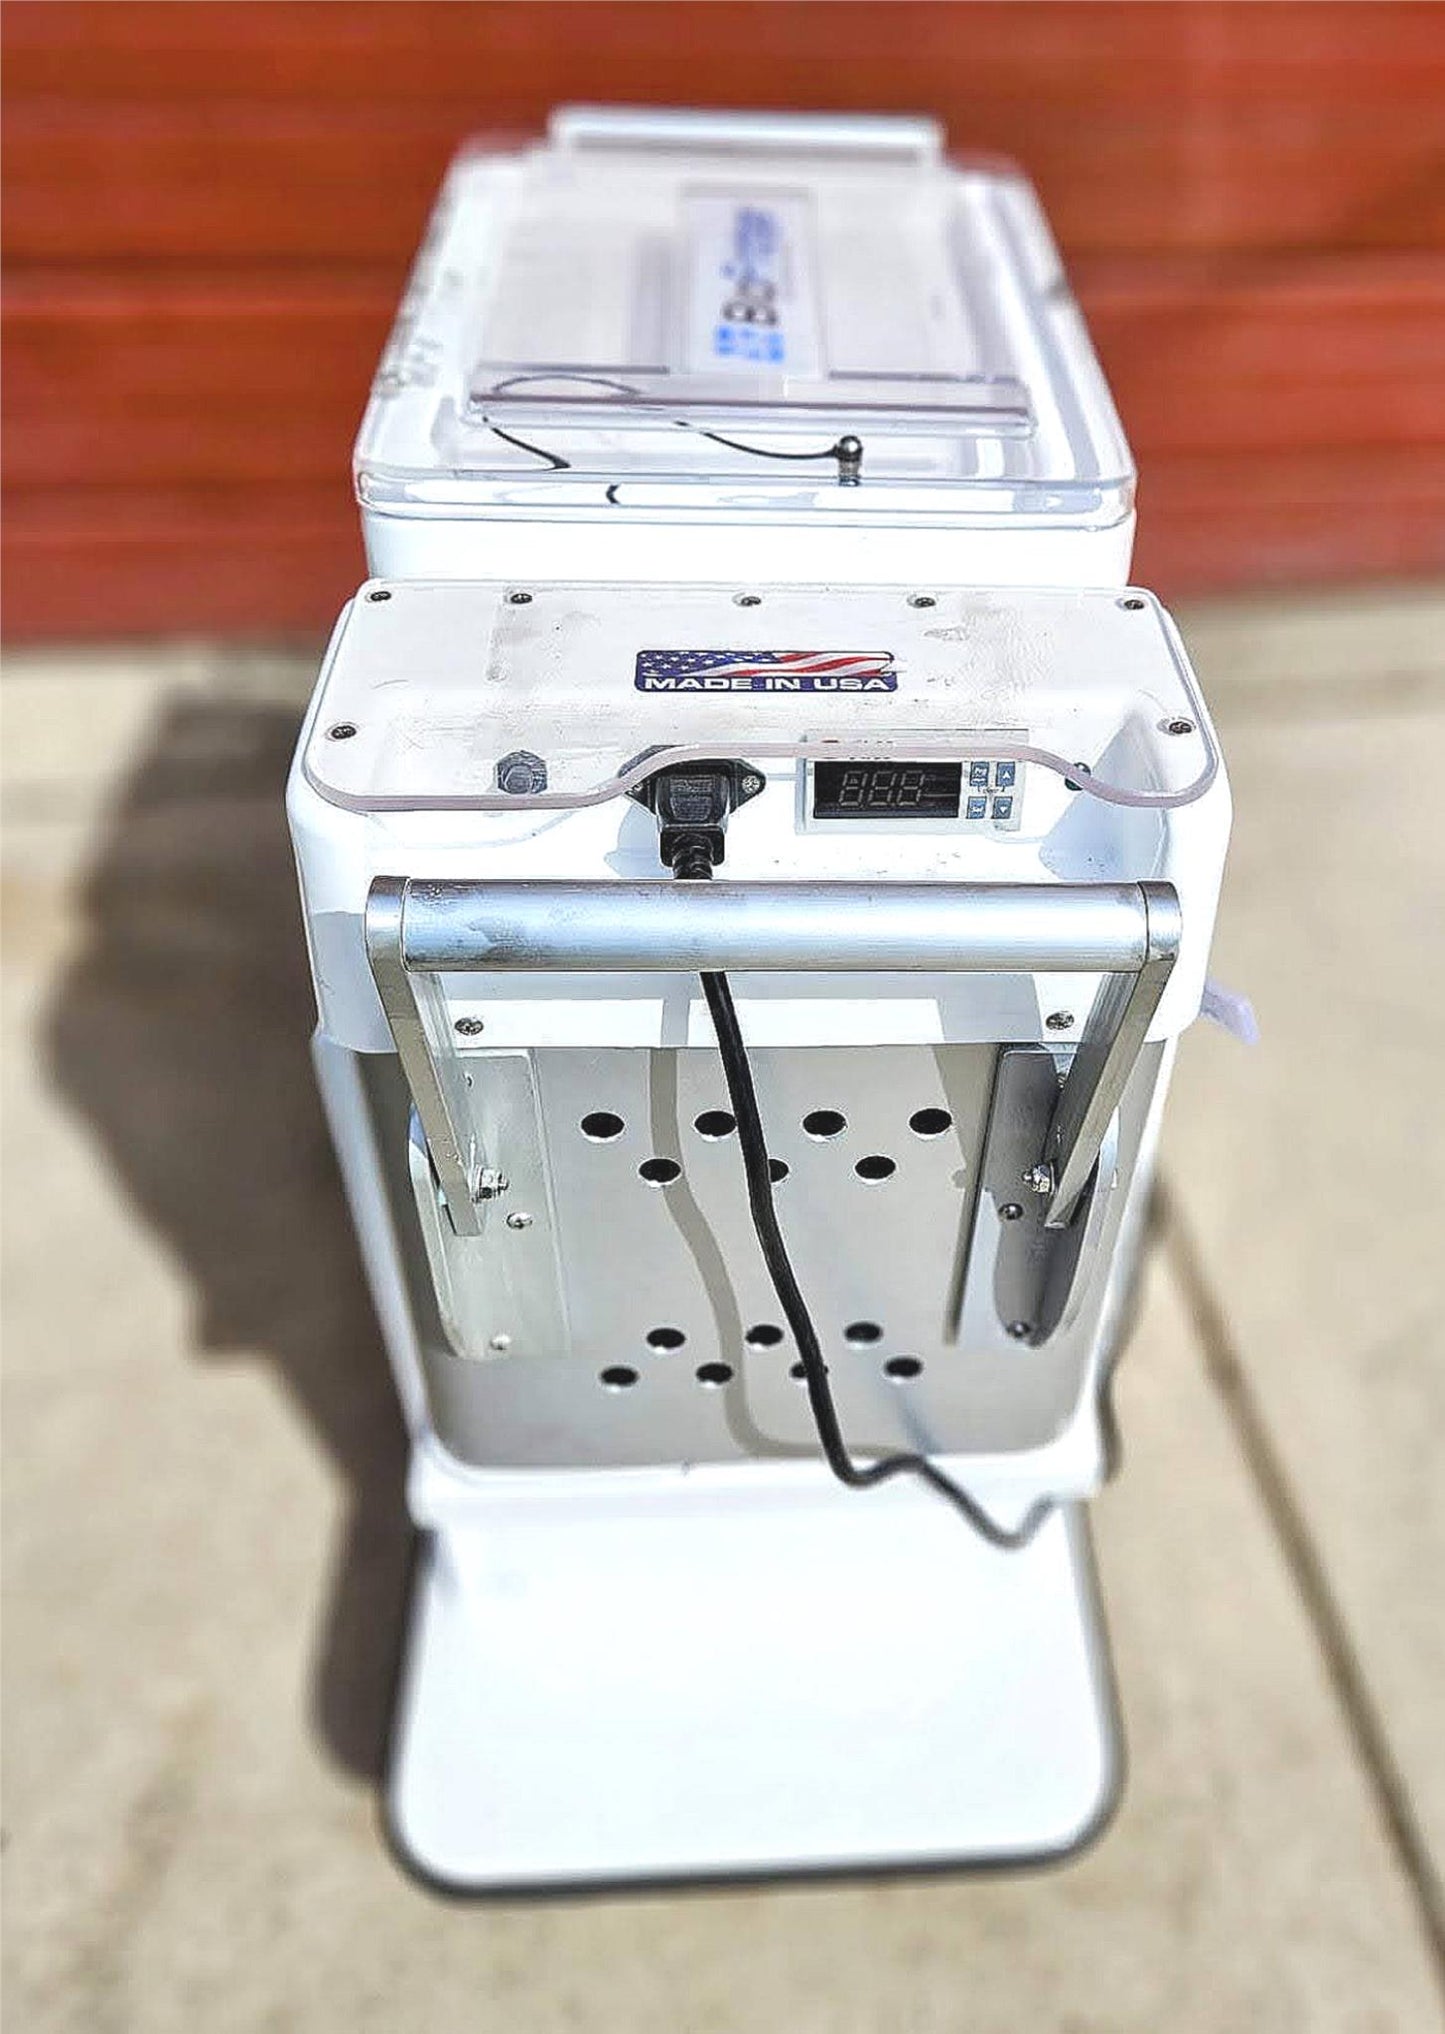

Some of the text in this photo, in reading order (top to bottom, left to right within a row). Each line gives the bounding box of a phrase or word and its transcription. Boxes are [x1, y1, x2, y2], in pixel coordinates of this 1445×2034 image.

[645, 677, 890, 691] MADE IN USA
